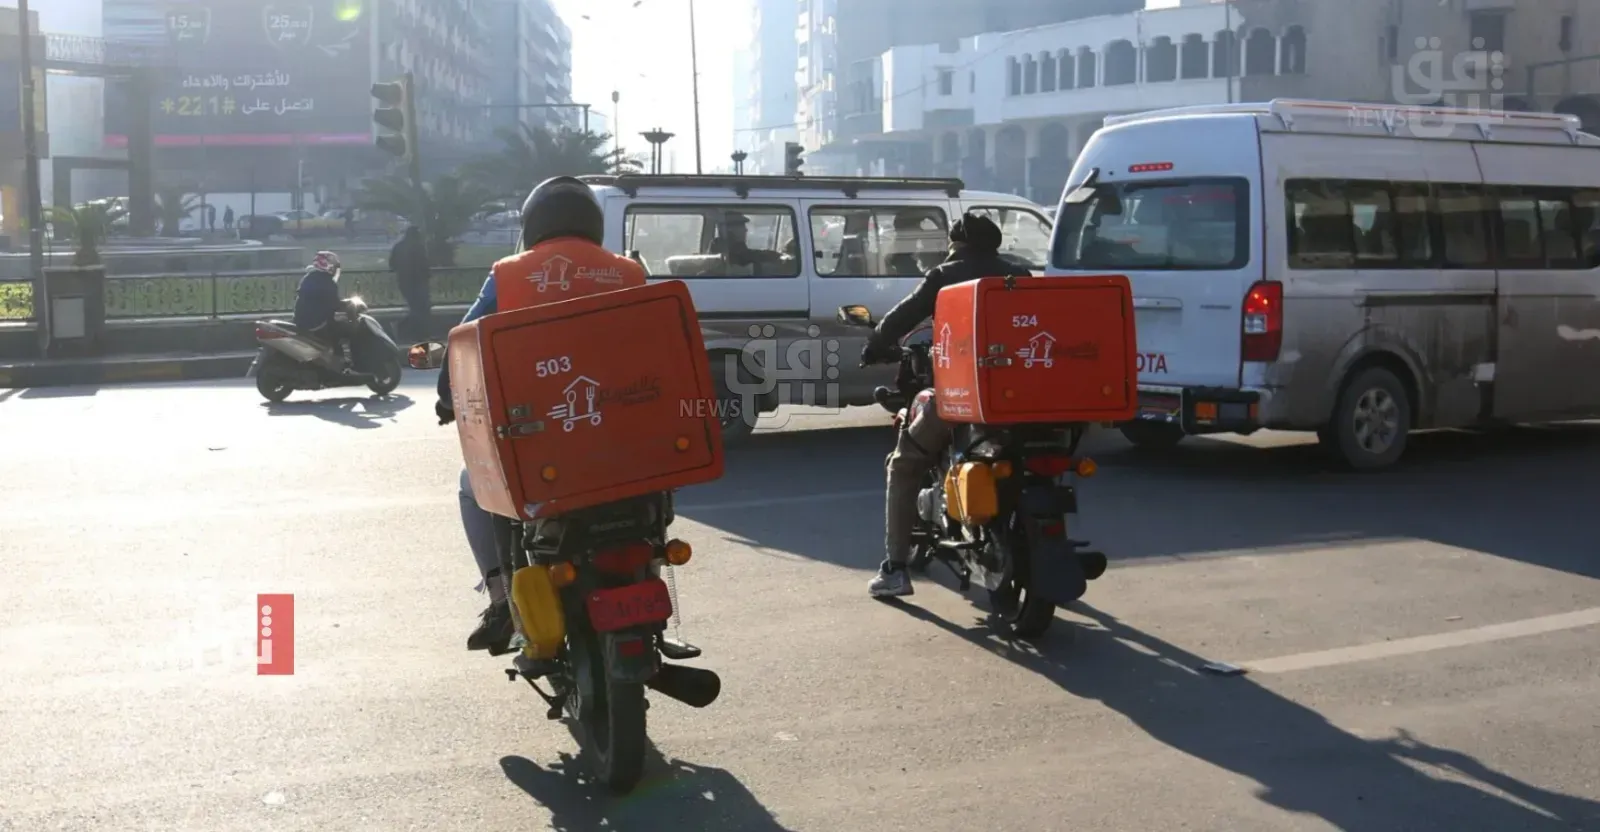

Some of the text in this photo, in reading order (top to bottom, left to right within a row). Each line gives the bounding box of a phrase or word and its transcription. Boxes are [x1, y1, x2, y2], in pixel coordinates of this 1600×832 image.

[242, 98, 271, 114] على
[1012, 315, 1038, 328] 524
[535, 356, 572, 378] 503
[1136, 352, 1168, 375] OTA
